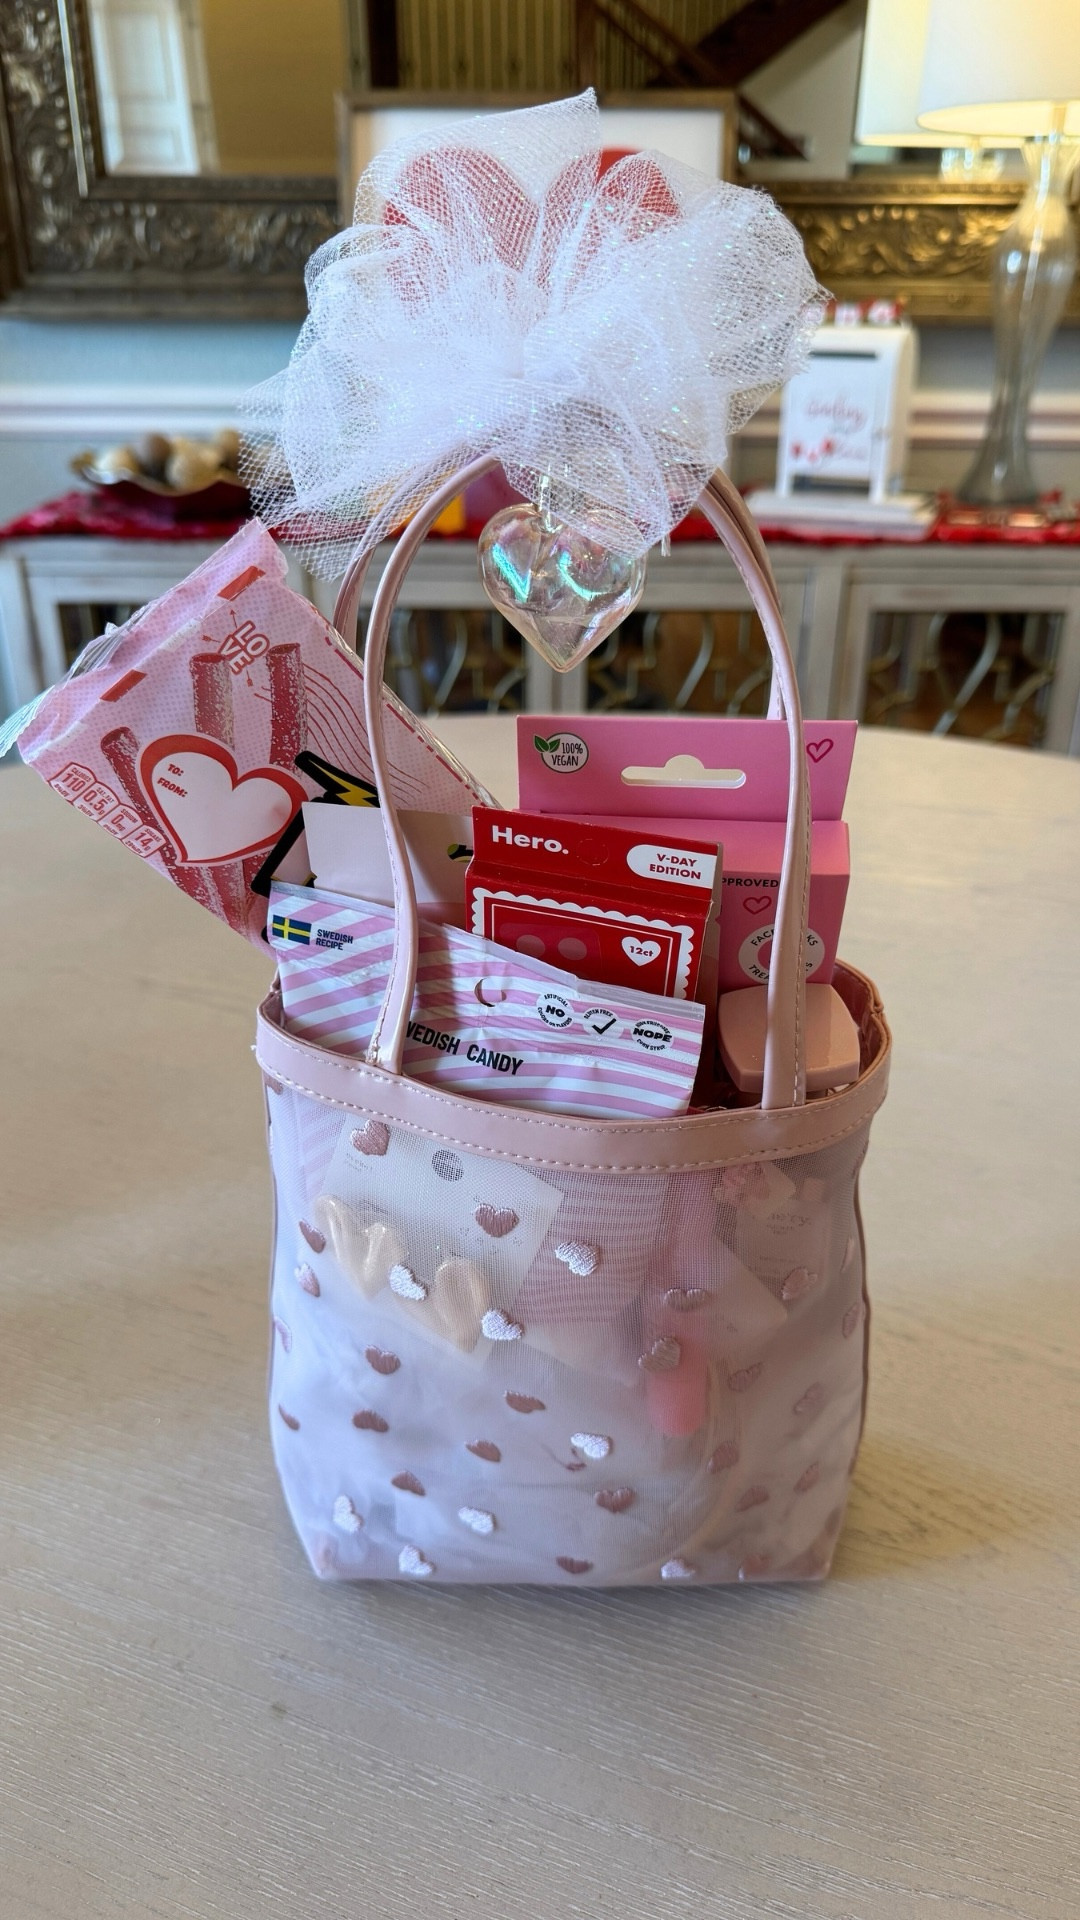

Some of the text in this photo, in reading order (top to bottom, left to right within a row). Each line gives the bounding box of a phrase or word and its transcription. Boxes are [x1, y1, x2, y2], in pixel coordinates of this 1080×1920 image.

[561, 742, 583, 754] 100%
[551, 755, 579, 766] VEGAN
[168, 763, 184, 777] TO:
[62, 773, 86, 792] 110
[157, 777, 188, 798] FROM:
[492, 825, 569, 855] Hero.
[656, 853, 698, 867] V-DAY
[649, 864, 702, 880] EDITION
[721, 877, 779, 888] PROVED
[316, 929, 354, 944] SWEDISH
[315, 938, 344, 950] RECIPE
[629, 945, 654, 957] 12ct
[545, 1004, 565, 1018] NO
[633, 1027, 673, 1043] NOPE
[466, 1044, 524, 1076] CANDY
